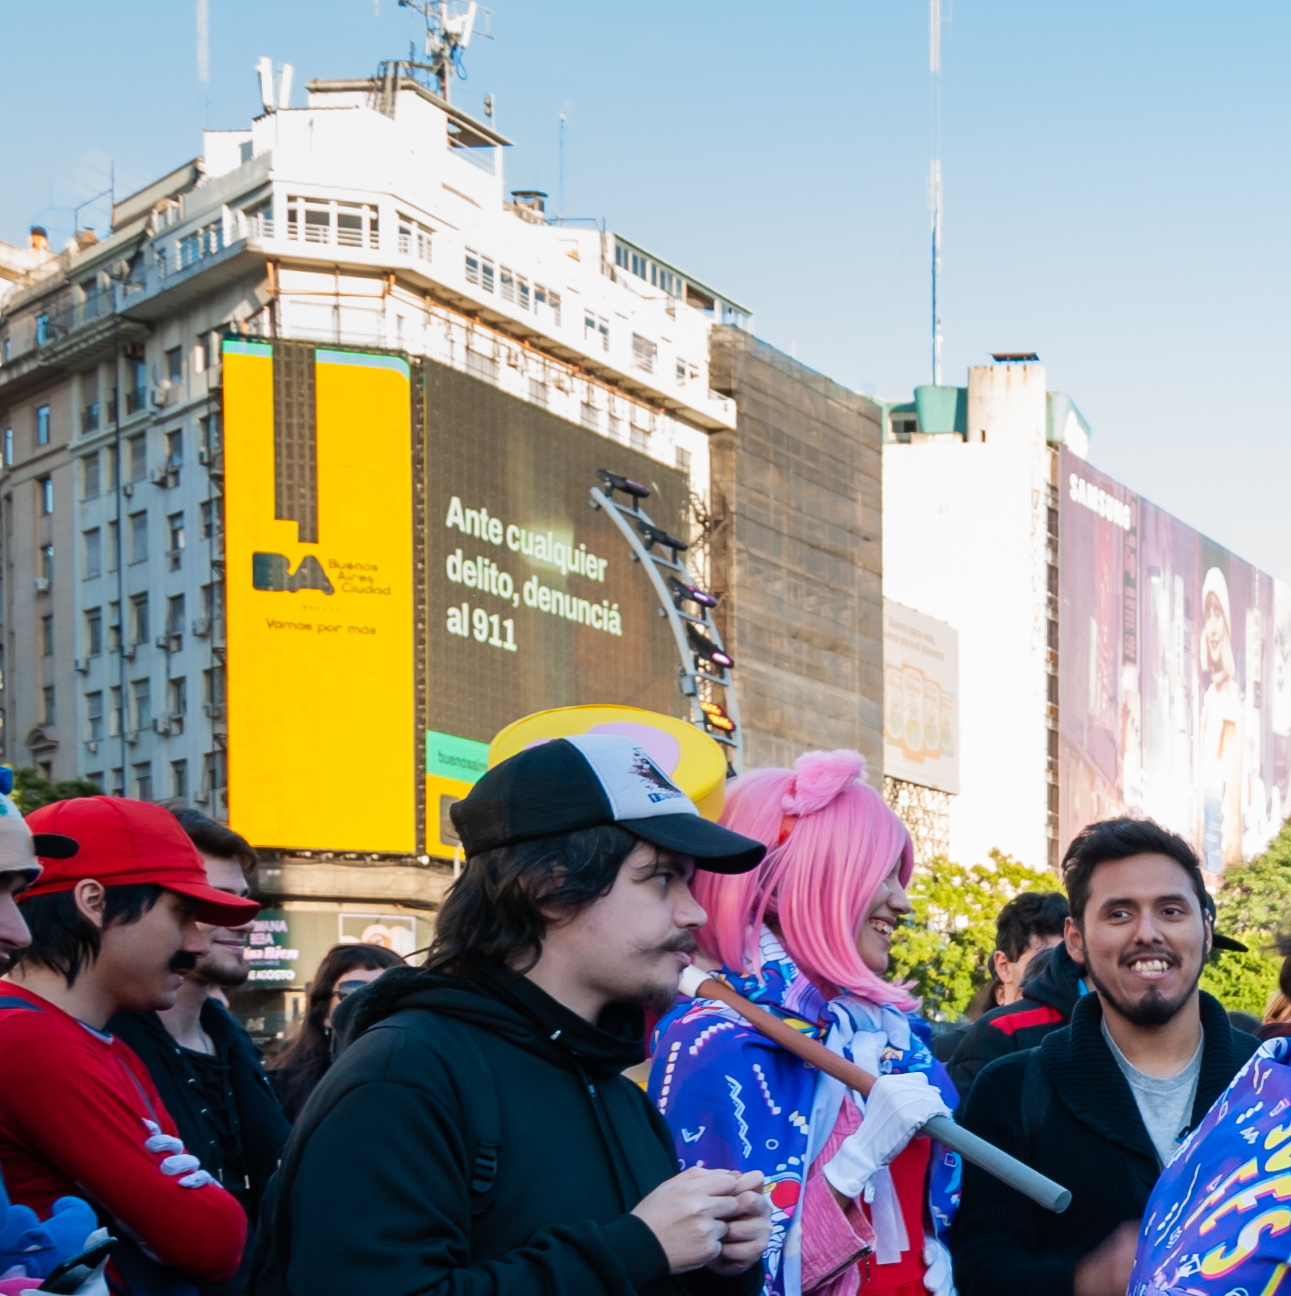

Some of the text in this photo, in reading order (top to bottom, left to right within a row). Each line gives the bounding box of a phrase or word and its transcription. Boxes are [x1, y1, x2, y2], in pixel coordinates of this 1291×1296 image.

[1069, 473, 1131, 531] SAMSUNG
[446, 496, 608, 582] Ante cualquier
[328, 559, 378, 572] Buenos
[338, 571, 374, 583] Aires
[341, 582, 391, 596] Ciudad
[446, 548, 622, 636] delito, denunciá
[265, 618, 312, 631] Vamos
[317, 624, 342, 634] por
[446, 602, 517, 652] al 911
